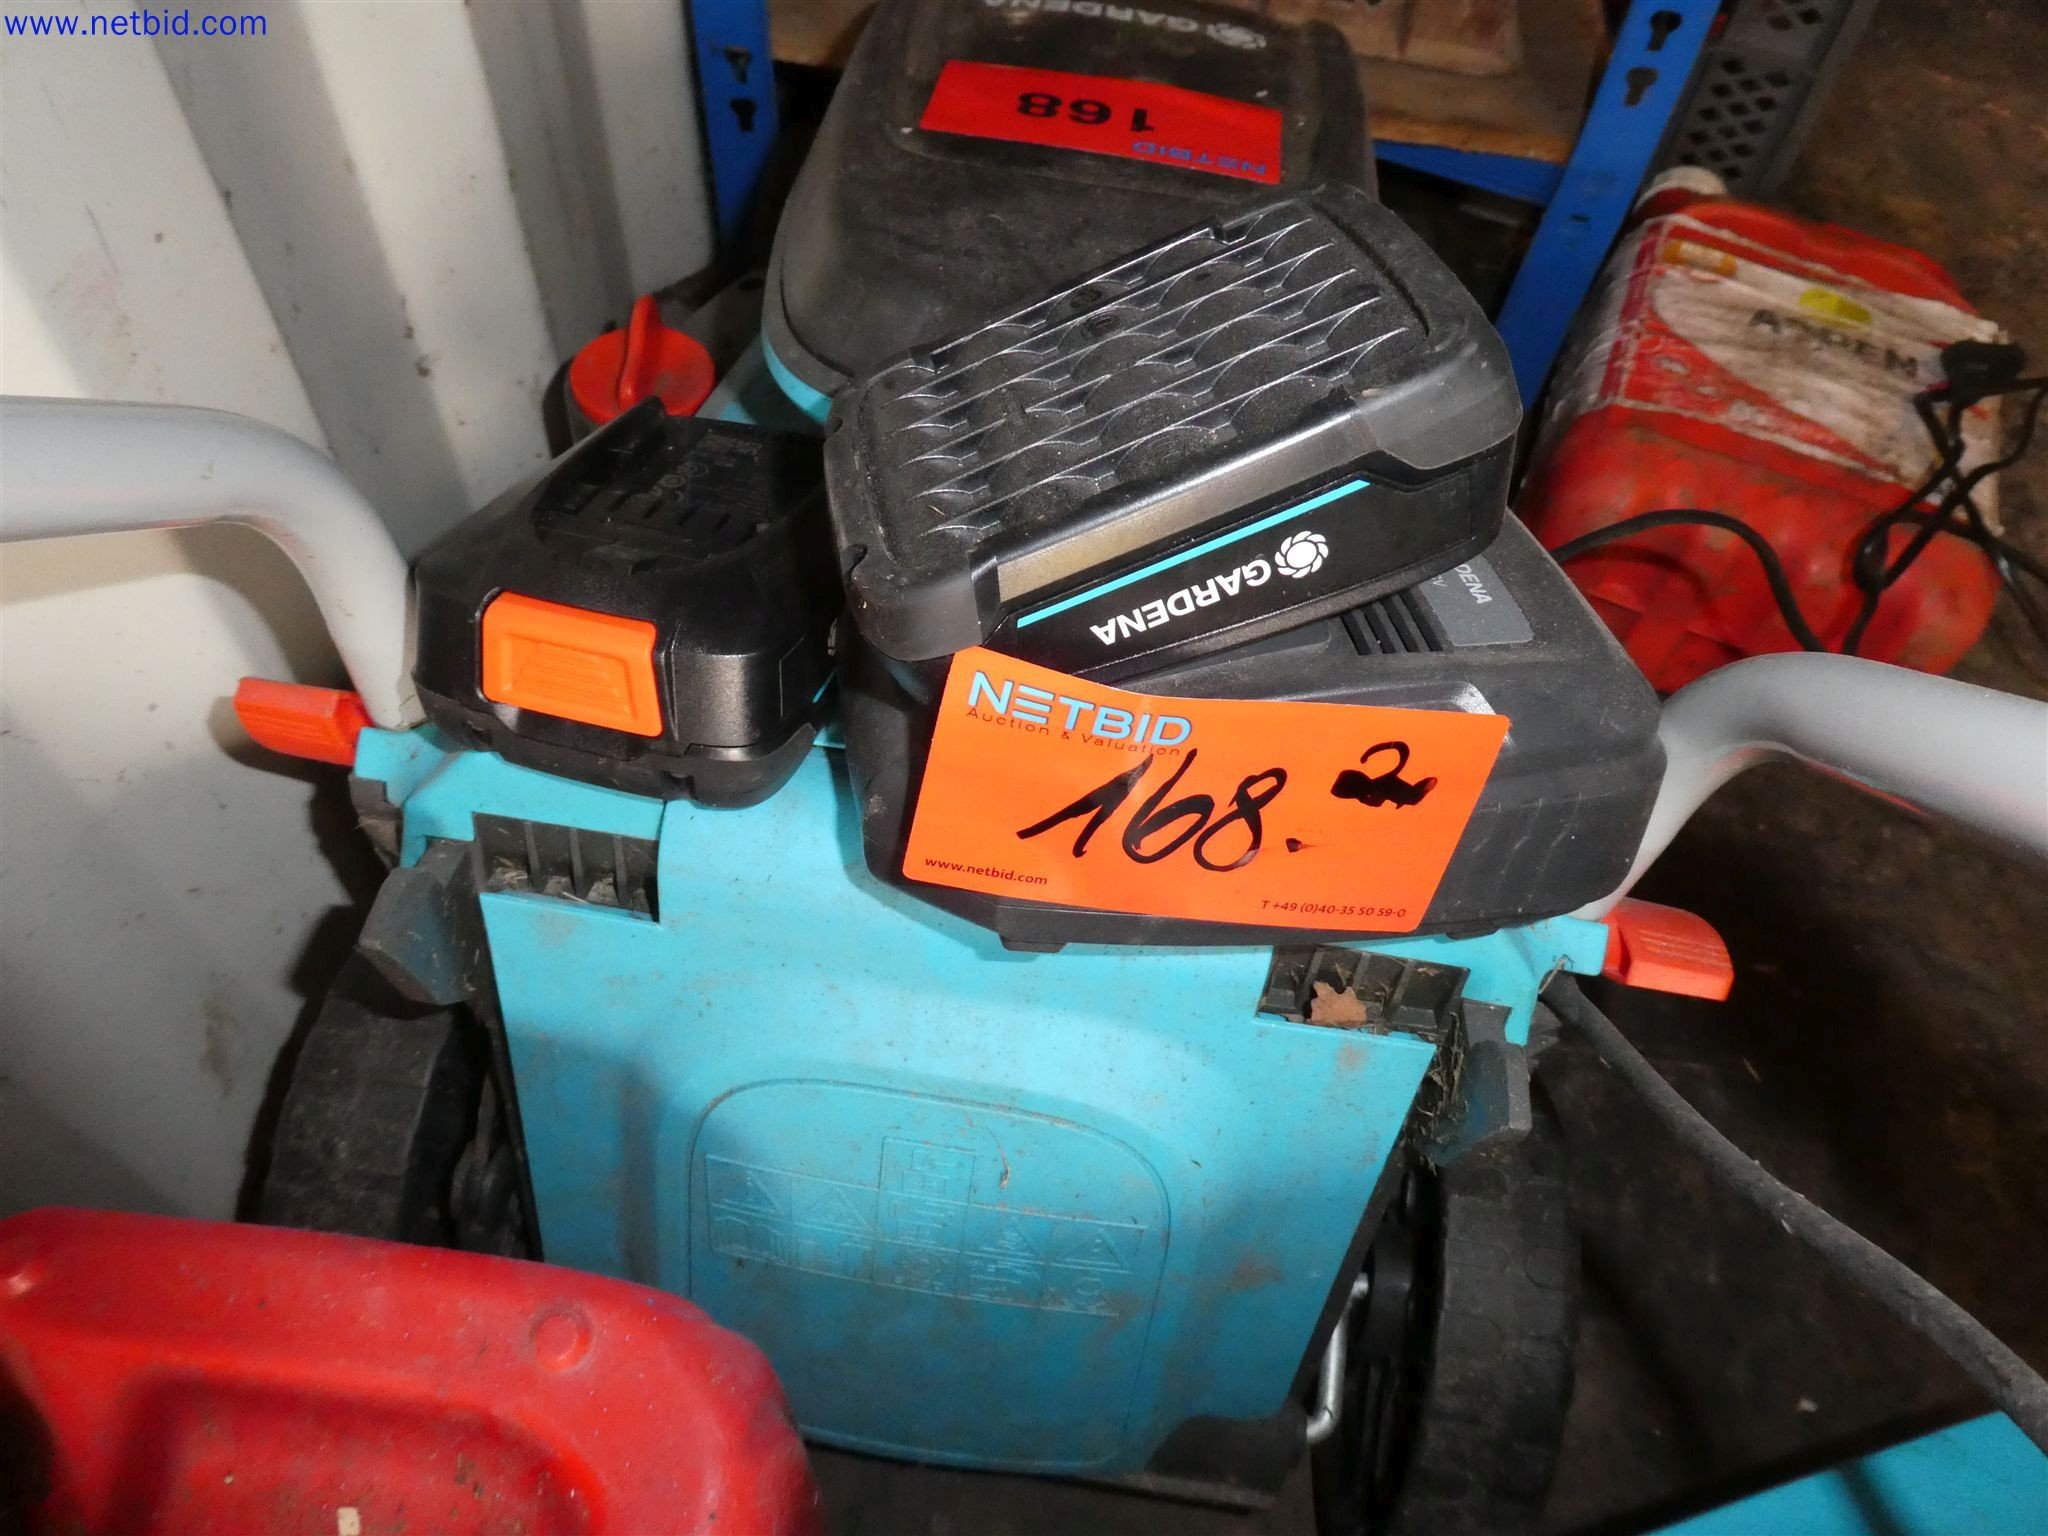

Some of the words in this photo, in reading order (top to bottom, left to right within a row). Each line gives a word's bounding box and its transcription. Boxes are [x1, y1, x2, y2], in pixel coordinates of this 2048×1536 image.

[1017, 92, 1155, 132] 168
[1132, 140, 1267, 175] NETBID
[1089, 558, 1273, 646] GARDENA
[968, 670, 1193, 747] NETBID
[966, 706, 1050, 736] Auction
[1060, 730, 1071, 740] &
[1081, 733, 1180, 757] Valuation
[925, 857, 1048, 886] www.netbid.com
[1262, 899, 1270, 910] T
[1272, 901, 1298, 912] +49
[1300, 903, 1354, 915] (0)40-35
[1357, 906, 1375, 917] 50
[1377, 907, 1406, 918] 59-0
